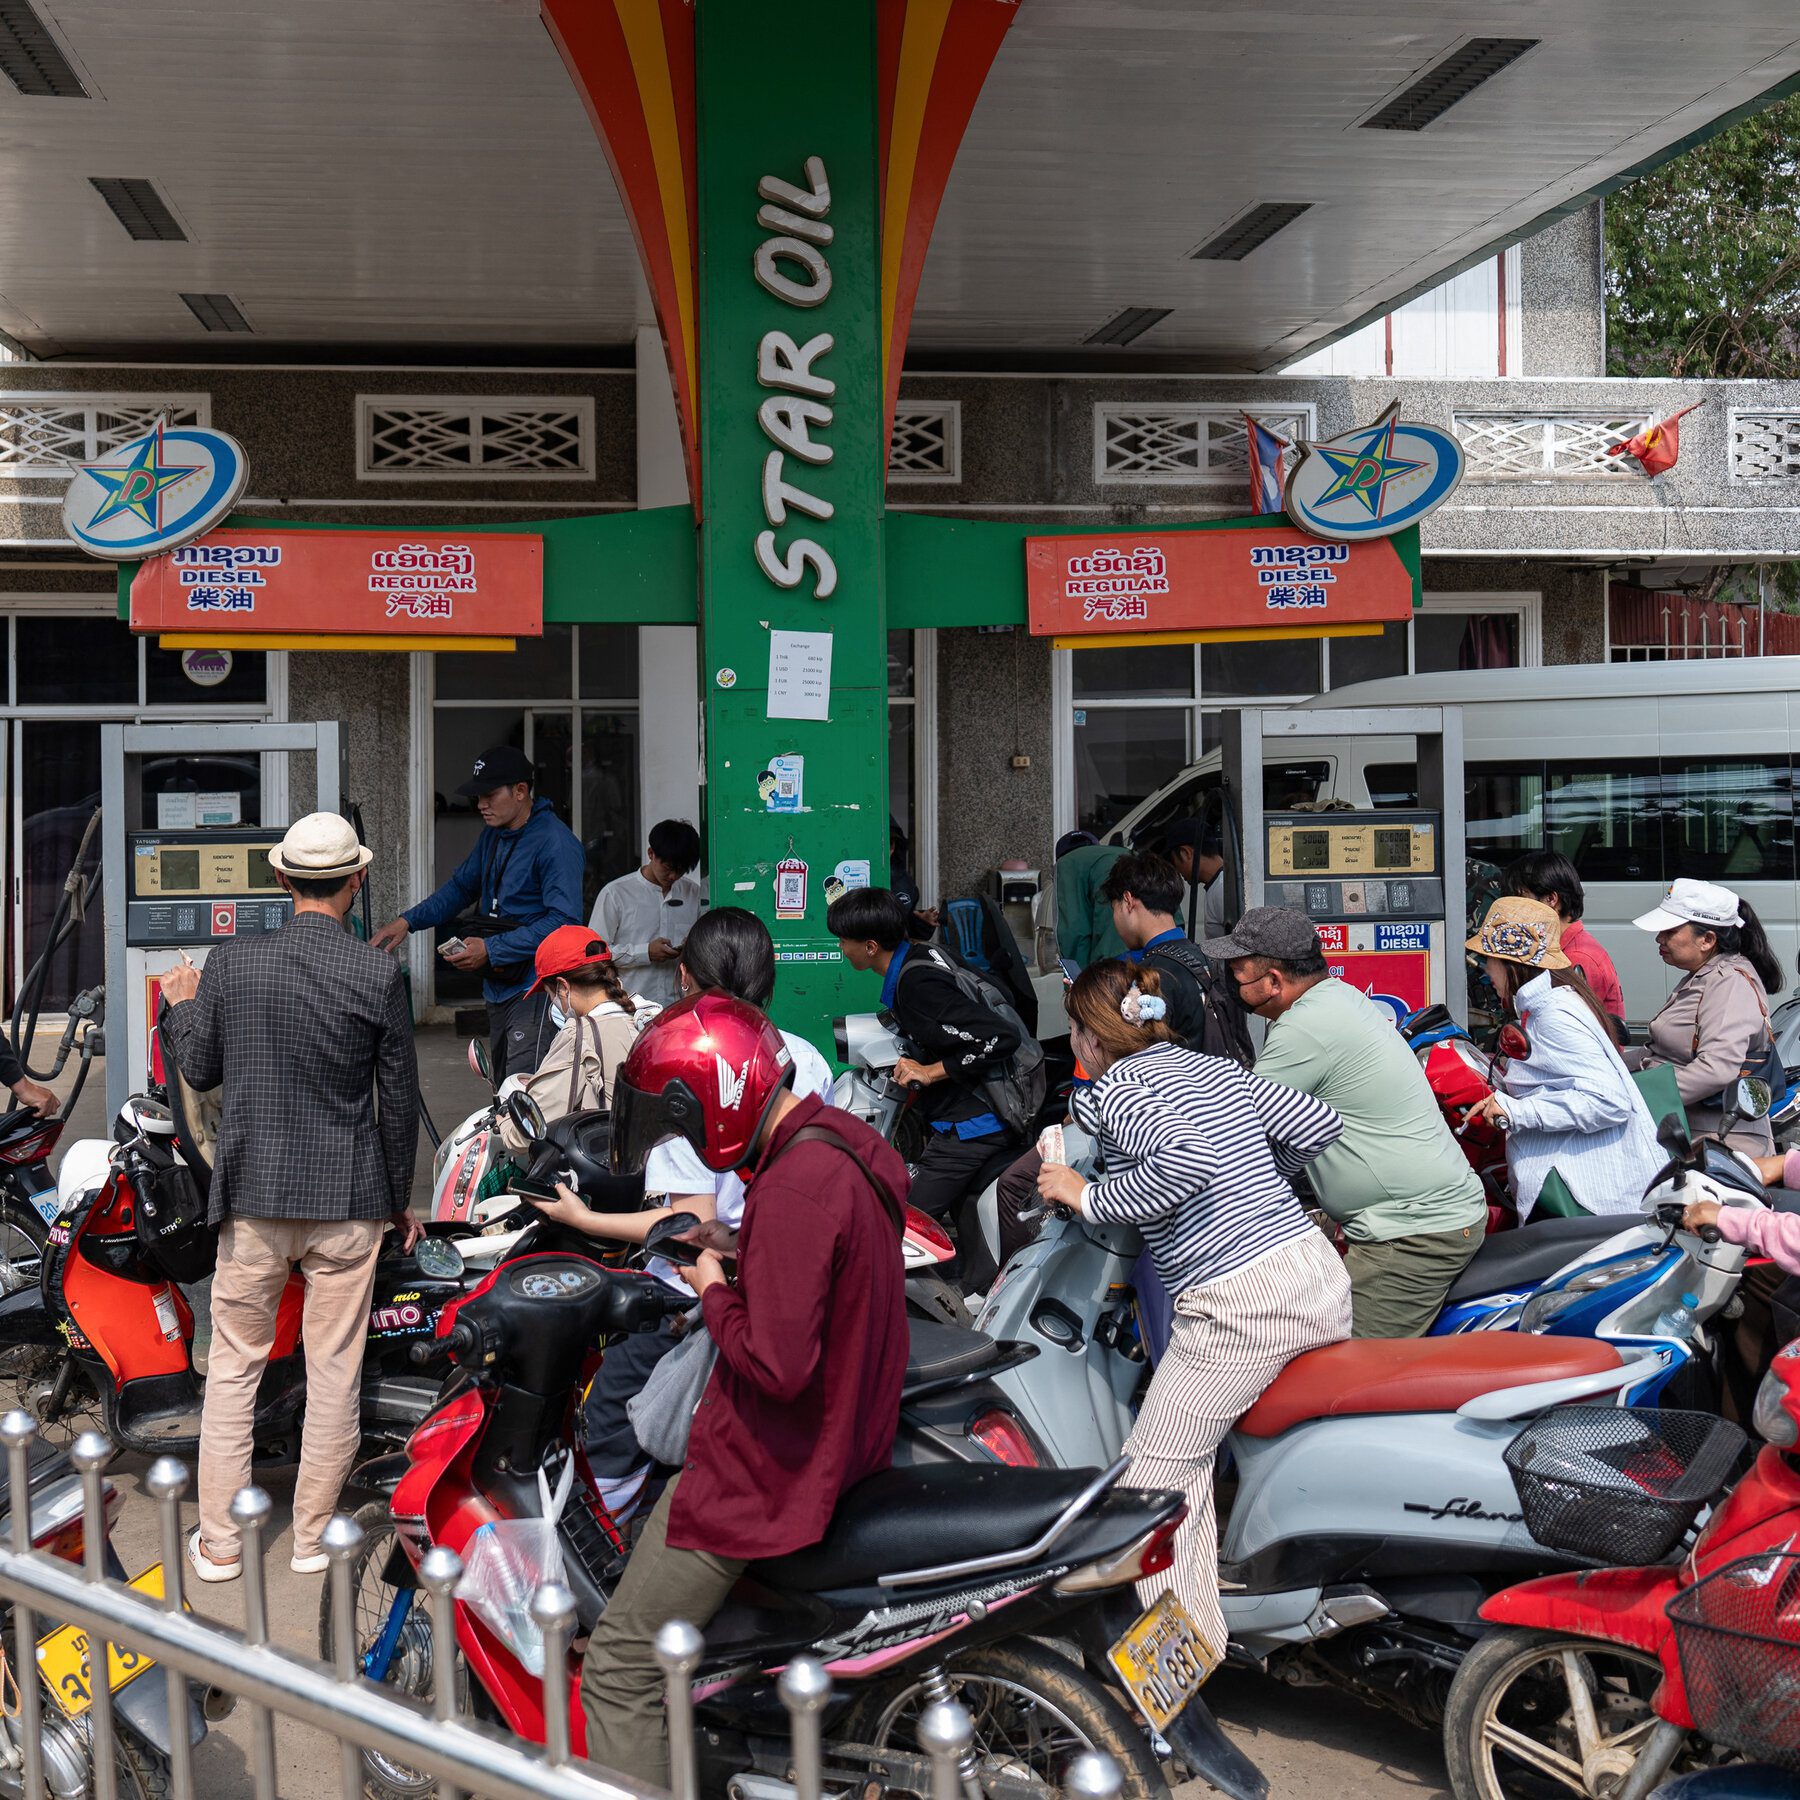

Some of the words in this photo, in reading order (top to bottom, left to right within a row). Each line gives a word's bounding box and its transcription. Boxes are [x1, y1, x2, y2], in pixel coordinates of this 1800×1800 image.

[753, 155, 834, 307] OIL
[754, 330, 837, 599] STAR
[1252, 545, 1348, 567] ກາຊວນ
[181, 571, 264, 584] DIESEL
[370, 576, 475, 590] REGULAR
[1067, 578, 1167, 594] REGULAR
[1260, 570, 1335, 583] DIESEL
[189, 588, 253, 610] 柴油
[387, 593, 451, 616] 汽油
[1268, 585, 1326, 607] 柴油
[1086, 598, 1147, 619] 汽油
[1379, 924, 1425, 938] ກາຊວນ
[1380, 938, 1424, 949] DIESEL
[732, 1059, 750, 1112] HONDA
[159, 1222, 178, 1236] DTH
[393, 1291, 421, 1302] mio
[1165, 1628, 1213, 1690] 8871
